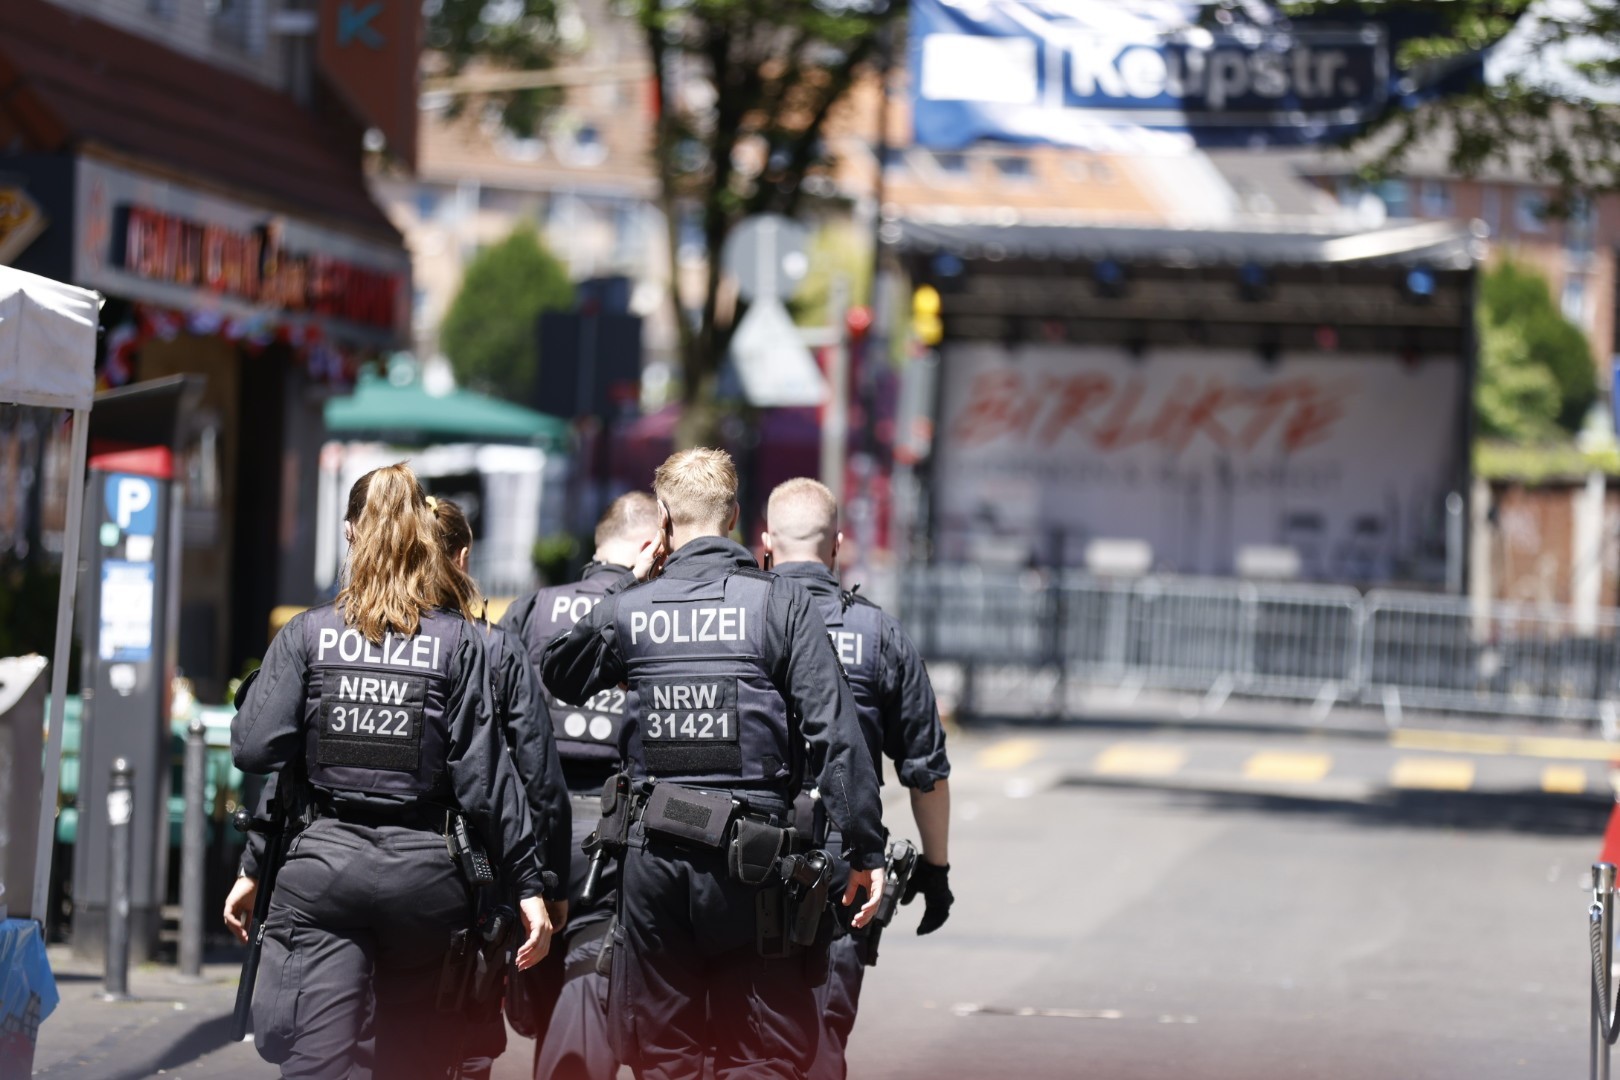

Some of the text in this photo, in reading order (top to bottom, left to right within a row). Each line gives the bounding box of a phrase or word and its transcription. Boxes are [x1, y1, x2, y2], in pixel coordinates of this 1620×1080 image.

[1070, 40, 1357, 109] Keupstr.
[117, 478, 151, 528] P
[551, 596, 601, 623] PO
[631, 608, 745, 645] POLIZEI
[318, 628, 440, 670] POLIZEI
[339, 676, 408, 705] NRW
[653, 685, 717, 709] NRW
[331, 706, 409, 736] 31422
[647, 713, 728, 738] 31421
